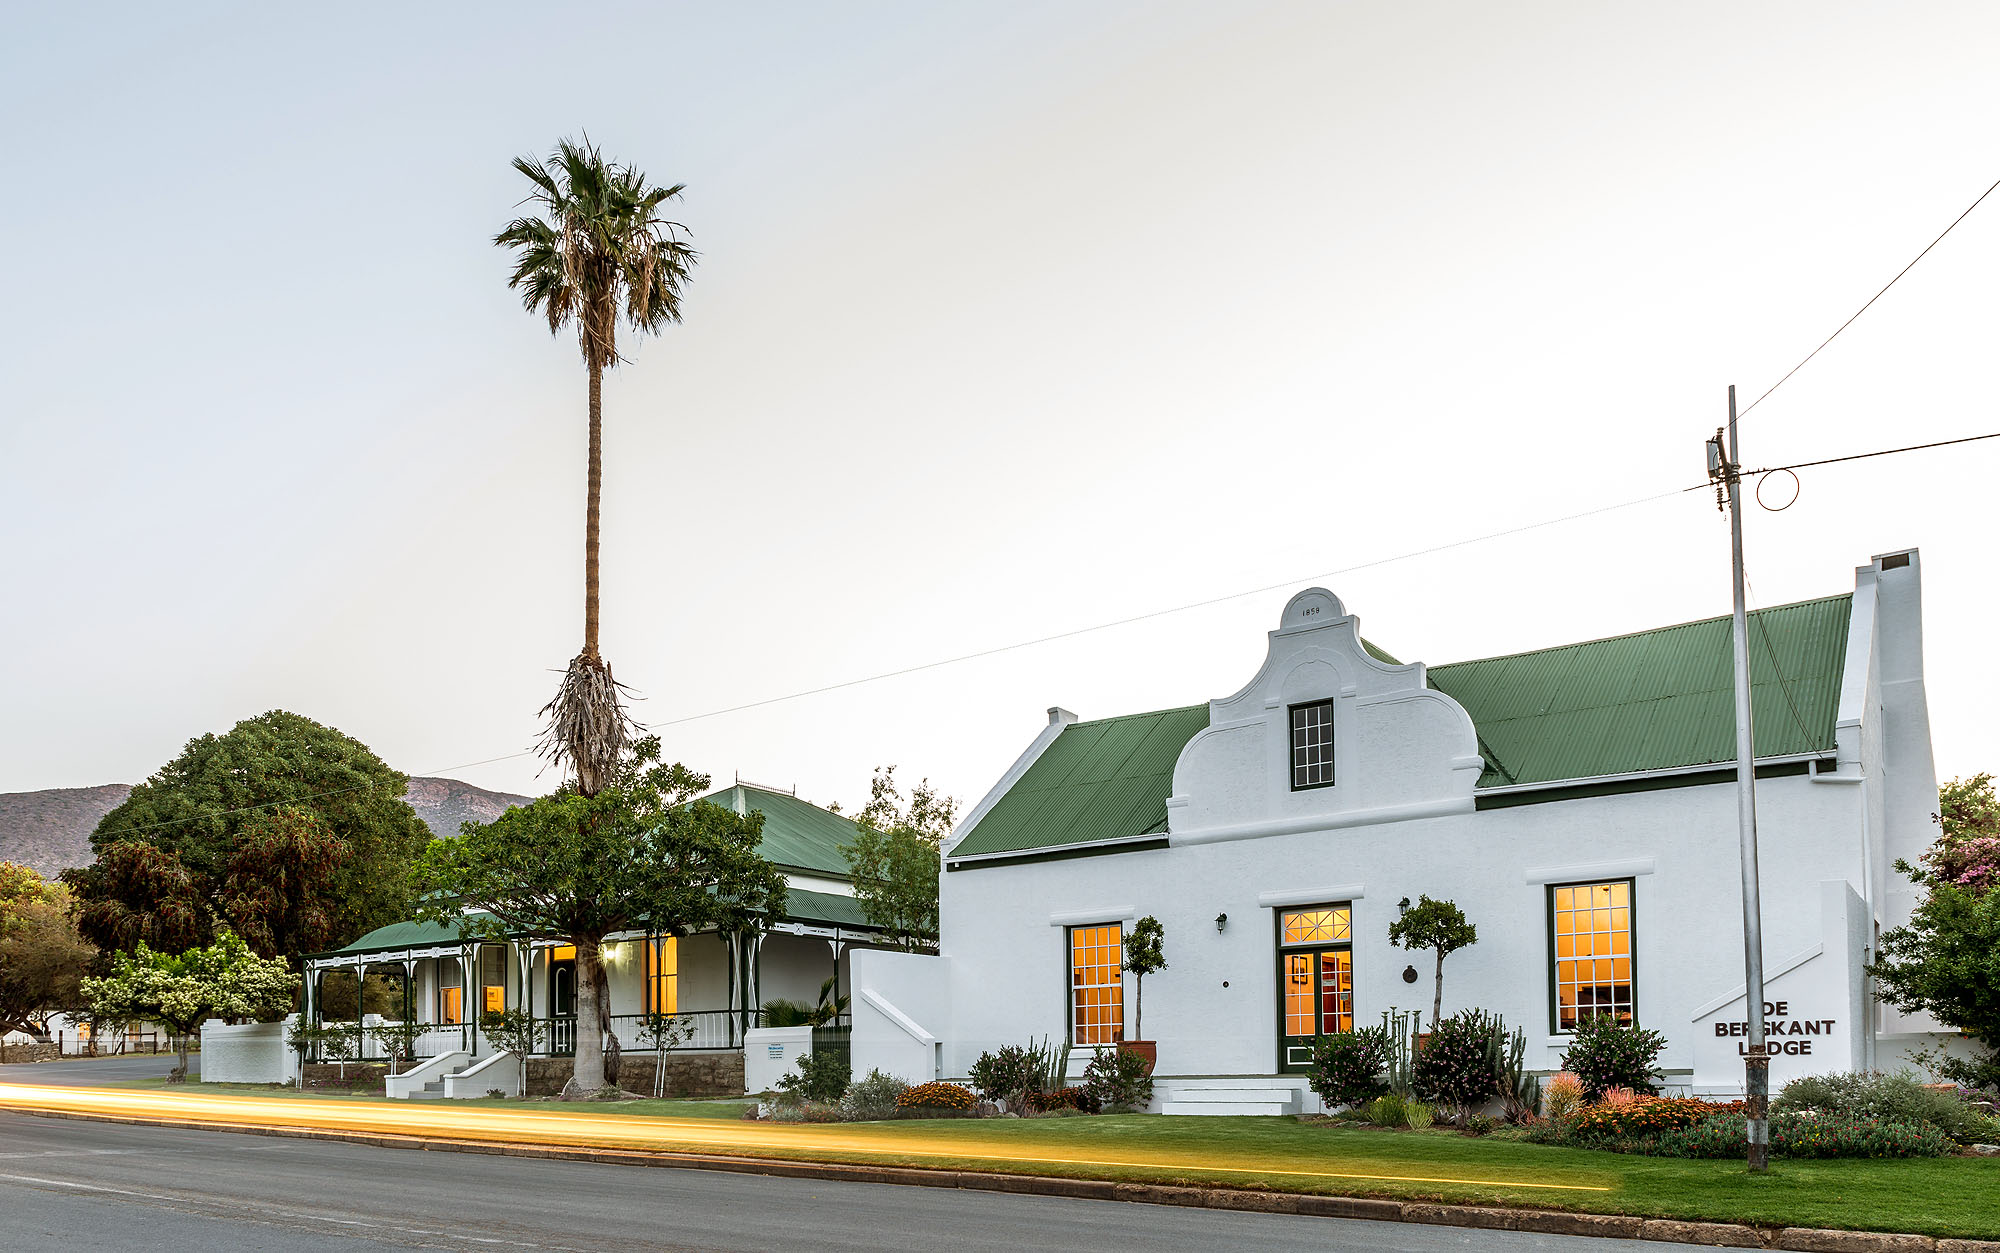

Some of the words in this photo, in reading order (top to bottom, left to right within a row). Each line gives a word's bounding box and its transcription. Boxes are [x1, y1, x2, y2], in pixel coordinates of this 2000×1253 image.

[1302, 607, 1320, 617] 1858
[1763, 1001, 1788, 1016] DE
[1738, 1041, 1812, 1056] LDGE
